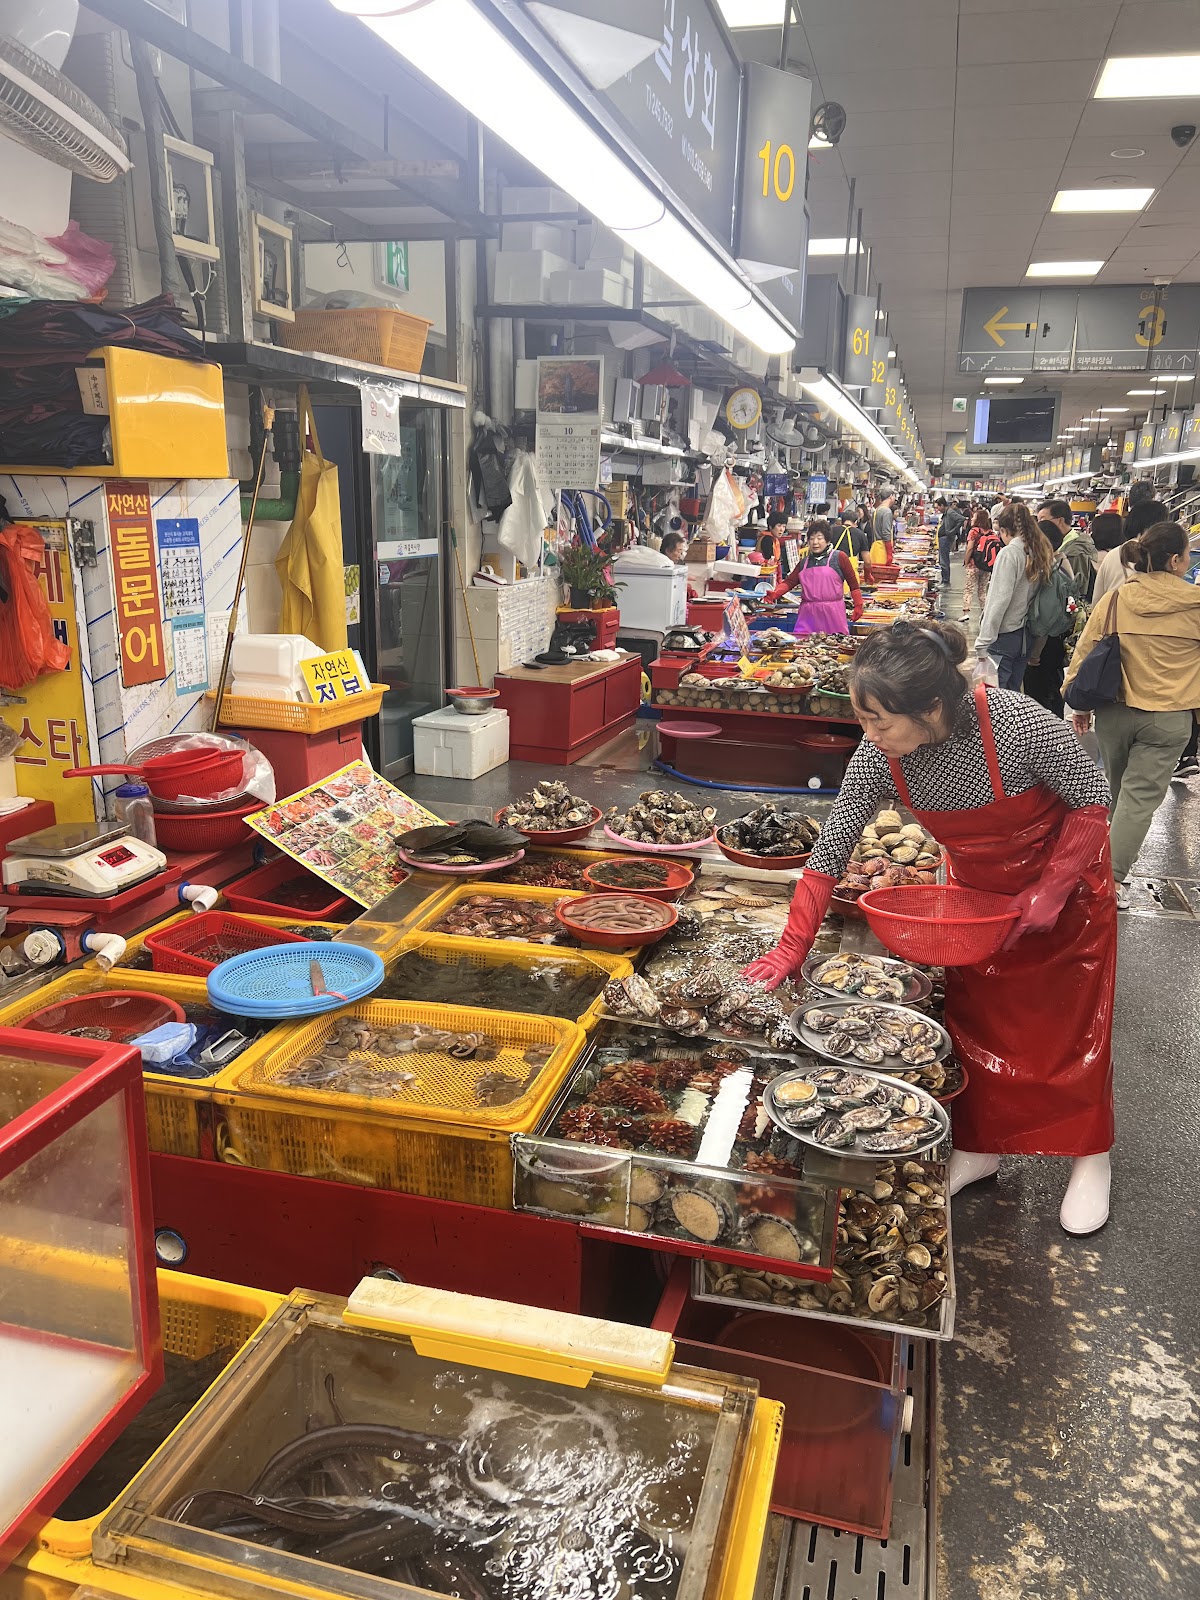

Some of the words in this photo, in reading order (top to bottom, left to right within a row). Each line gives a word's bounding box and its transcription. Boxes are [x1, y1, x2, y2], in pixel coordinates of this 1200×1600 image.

[758, 139, 796, 202] 10
[1135, 305, 1165, 347] 3
[853, 327, 870, 356] 61
[1077, 356, 1113, 365] 외부화장실
[564, 427, 574, 435] 10
[1168, 427, 1179, 440] 71
[1193, 418, 1200, 433] 7
[1124, 441, 1135, 453] 69
[1142, 435, 1152, 448] 70
[109, 494, 148, 516] 자연산
[116, 526, 159, 667] 돌문어
[311, 657, 351, 681] 자연산
[14, 716, 83, 769] 스타
